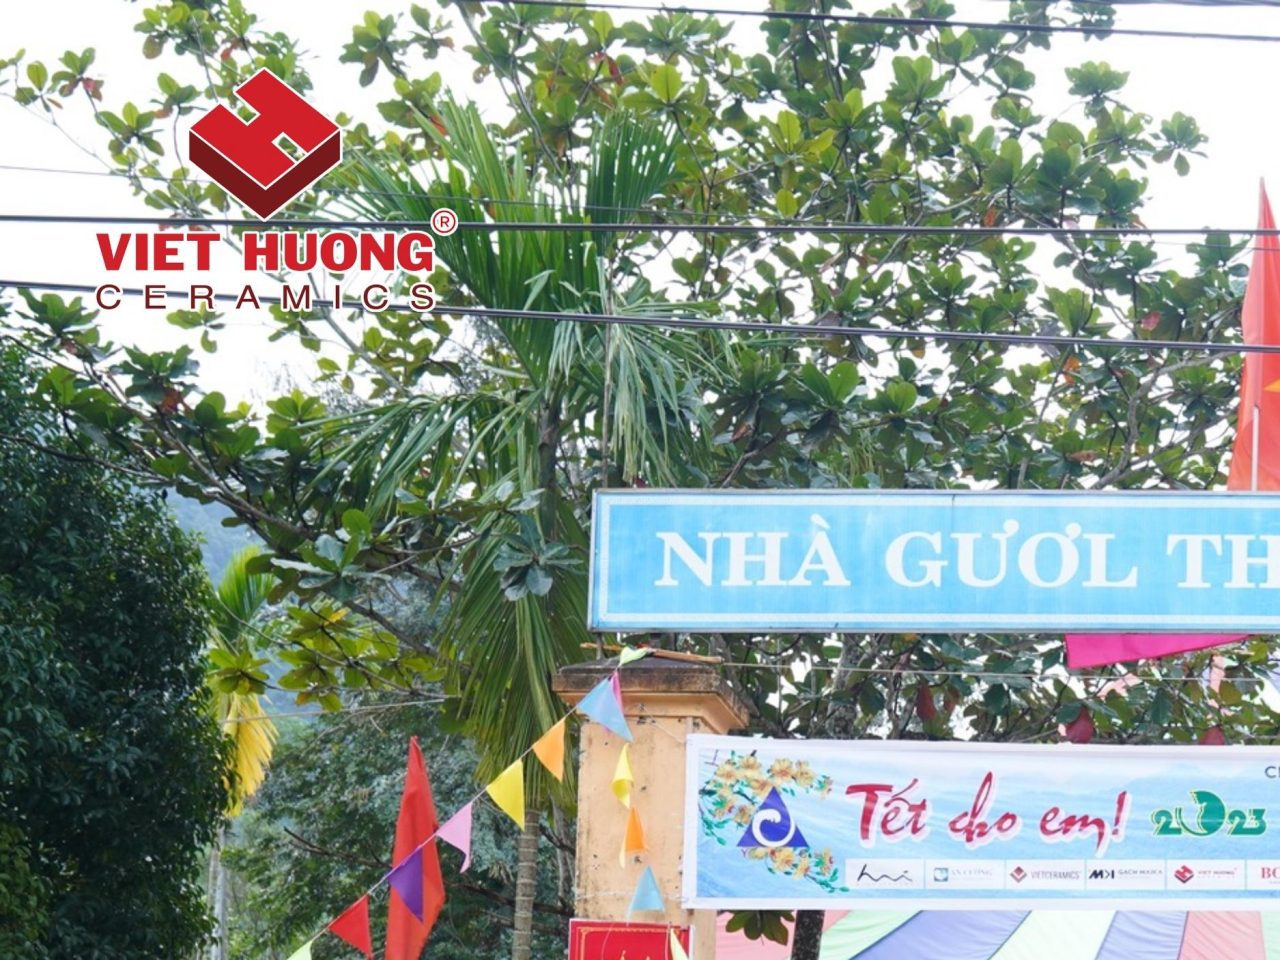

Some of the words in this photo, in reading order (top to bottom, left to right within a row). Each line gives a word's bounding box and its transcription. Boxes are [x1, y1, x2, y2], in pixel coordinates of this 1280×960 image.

[655, 513, 851, 587] NHÀ
[885, 518, 1138, 588] GƯƠL
[845, 778, 928, 841] Tết
[948, 771, 1018, 843] cho
[1039, 790, 1128, 852] em!
